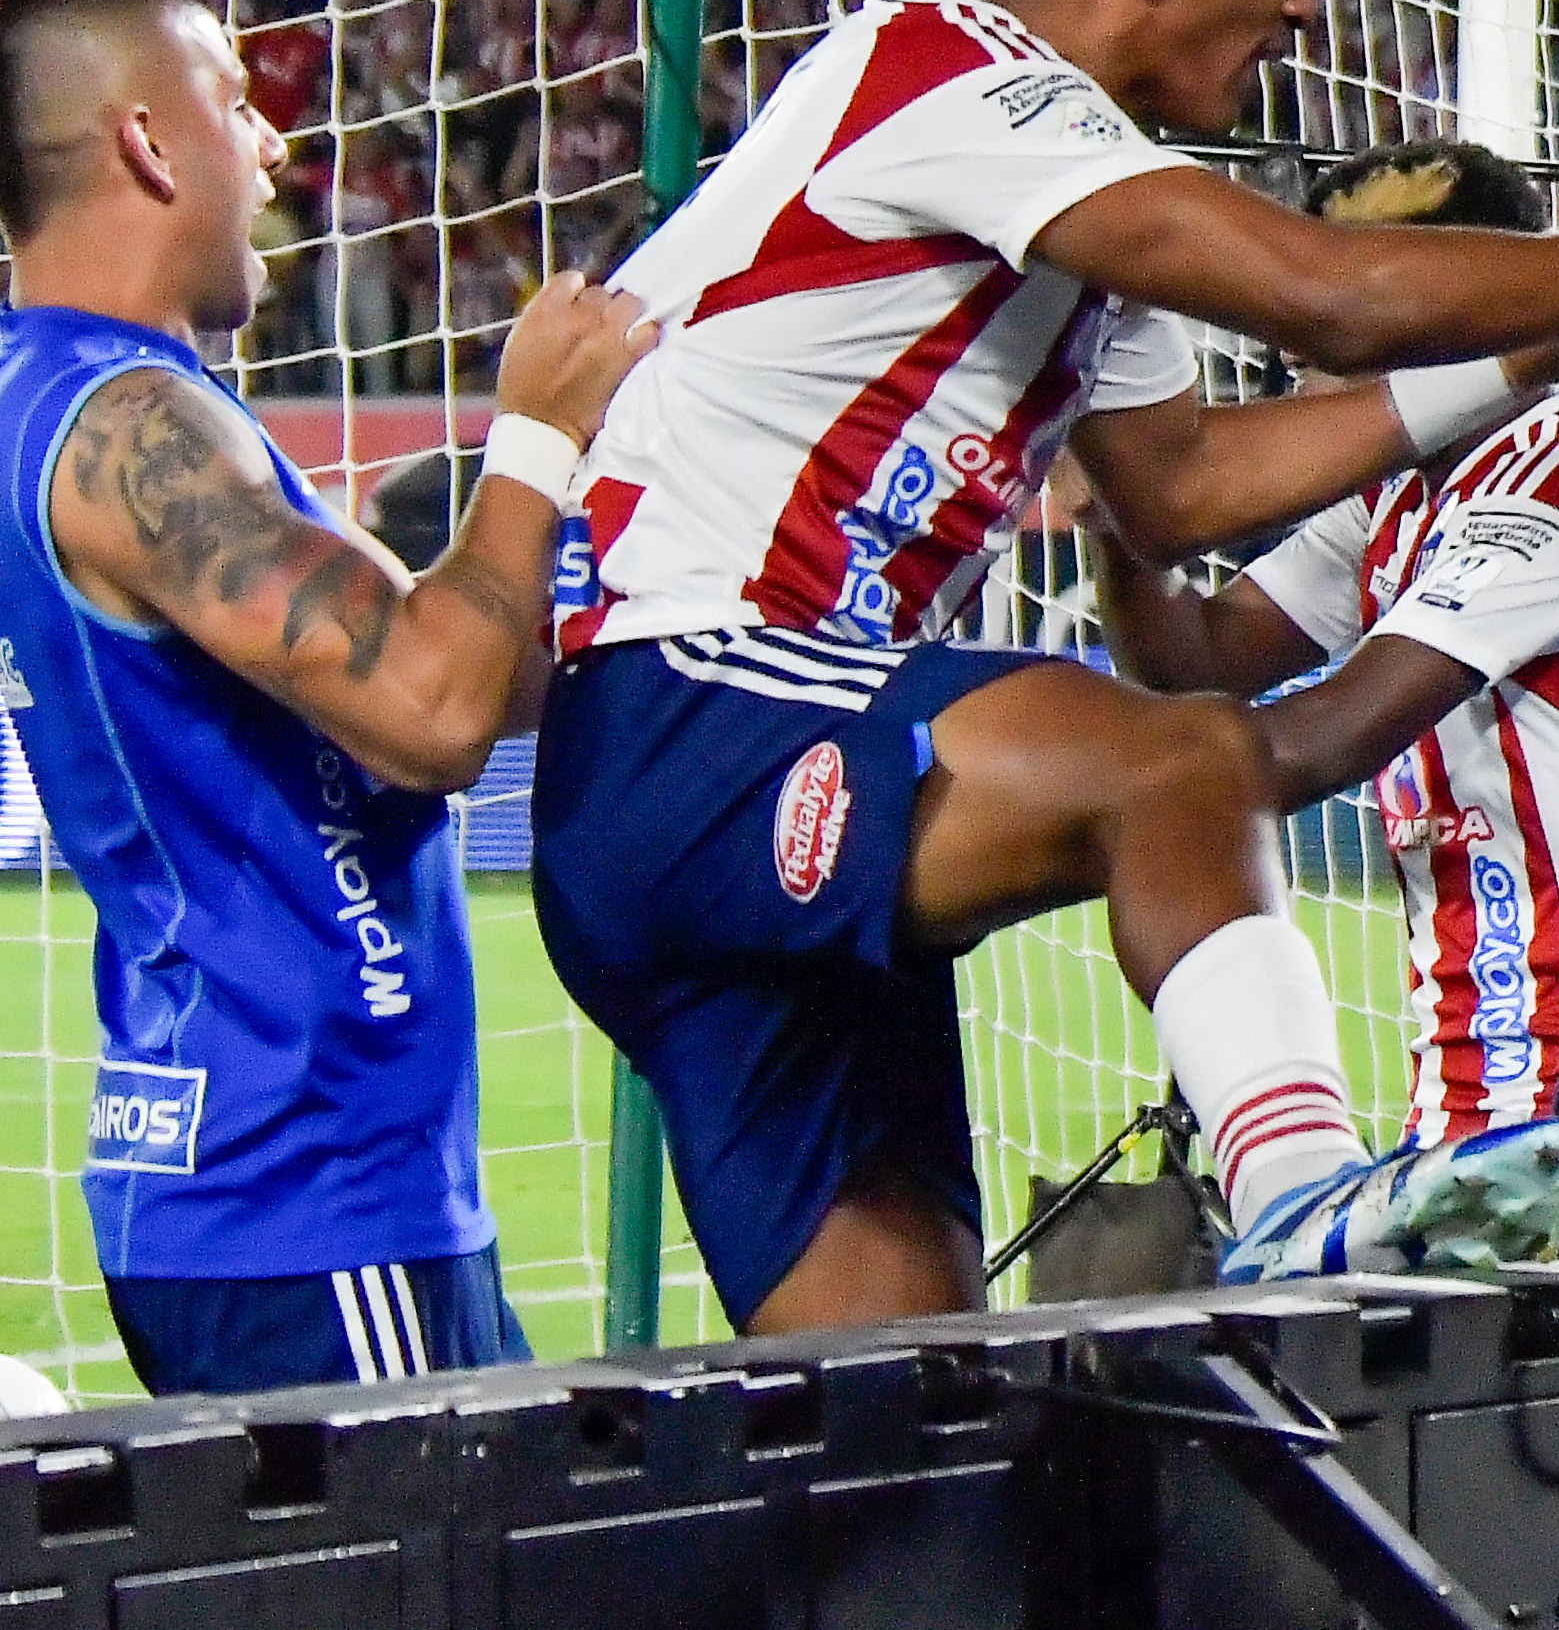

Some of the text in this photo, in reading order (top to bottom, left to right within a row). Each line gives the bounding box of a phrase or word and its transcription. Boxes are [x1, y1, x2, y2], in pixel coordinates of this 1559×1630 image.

[785, 748, 835, 888] Pedialyte
[815, 789, 852, 880] Active
[1478, 868, 1527, 1078] wplay.co
